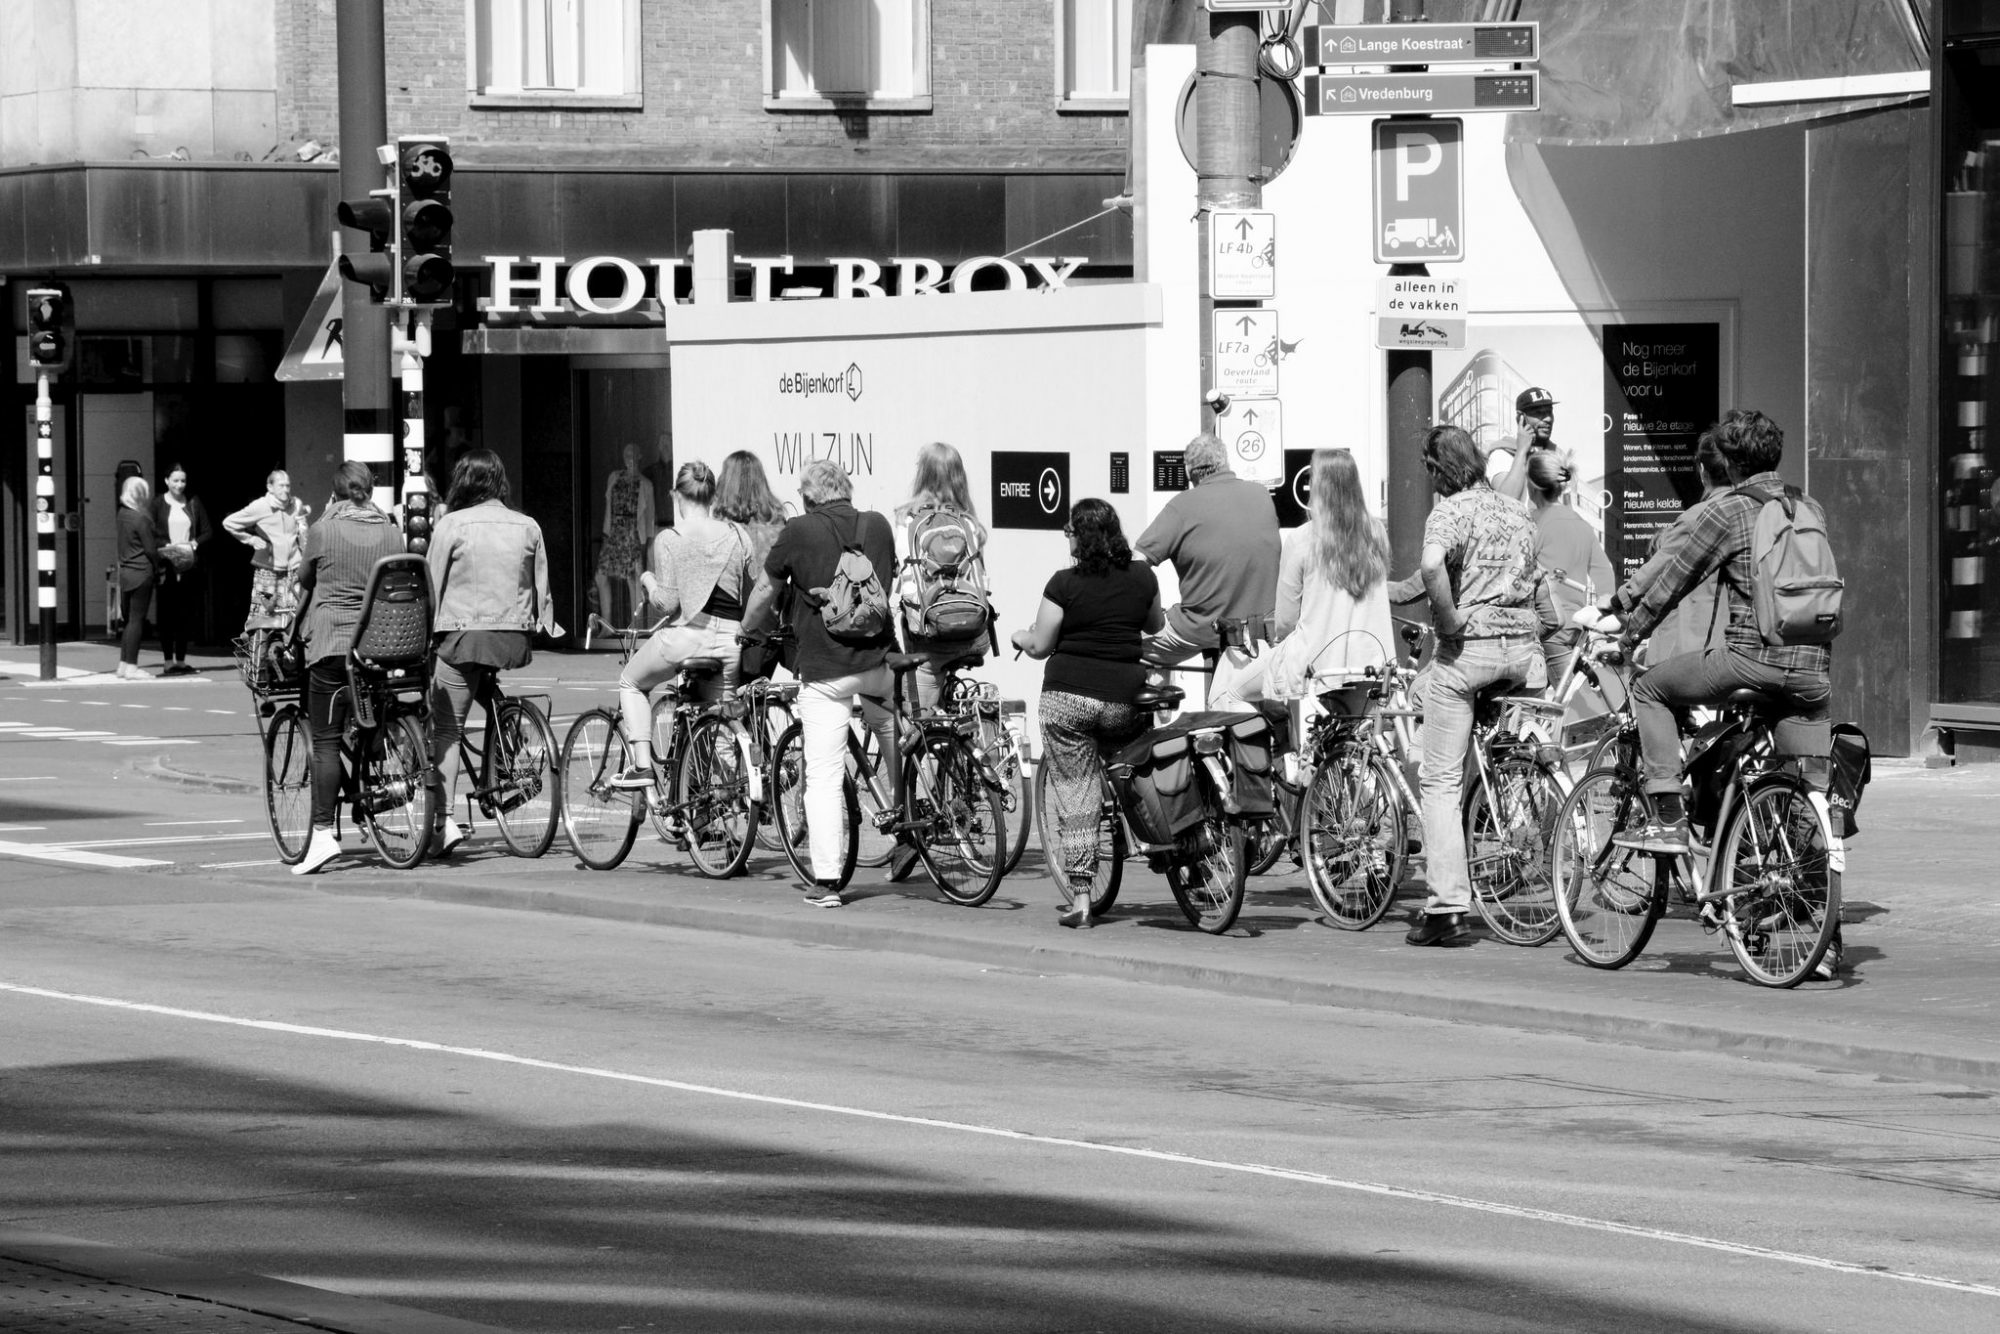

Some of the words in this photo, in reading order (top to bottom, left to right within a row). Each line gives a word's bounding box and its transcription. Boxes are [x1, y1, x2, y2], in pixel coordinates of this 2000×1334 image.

[1358, 39, 1398, 53] Lange
[1401, 37, 1463, 50] Koestraat
[1358, 86, 1433, 102] Vredenburg
[1396, 133, 1443, 201] P
[1394, 281, 1436, 293] alleen
[1441, 281, 1454, 293] in
[1388, 298, 1405, 309] de
[1409, 300, 1459, 311] vakken
[1622, 341, 1650, 359] Nog
[1653, 343, 1687, 355] meer
[1622, 361, 1640, 376] de
[1643, 360, 1697, 379] Bijenkorf
[1622, 384, 1652, 396] voor
[1654, 384, 1663, 396] u
[1623, 412, 1639, 420] Fase
[1639, 412, 1643, 420] 1
[1623, 420, 1655, 431] nieuwe
[1656, 420, 1668, 431] 2e
[1240, 437, 1261, 453] 26
[823, 432, 873, 476] ZIJN
[1000, 482, 1031, 497] ENTREE
[1623, 490, 1639, 498] Fase
[1639, 490, 1644, 498] 2
[1623, 499, 1655, 509] nieuwe
[1656, 498, 1682, 508] kelder
[1623, 557, 1639, 565] Fase
[1639, 557, 1645, 565] 3
[1831, 793, 1852, 810] Bec
